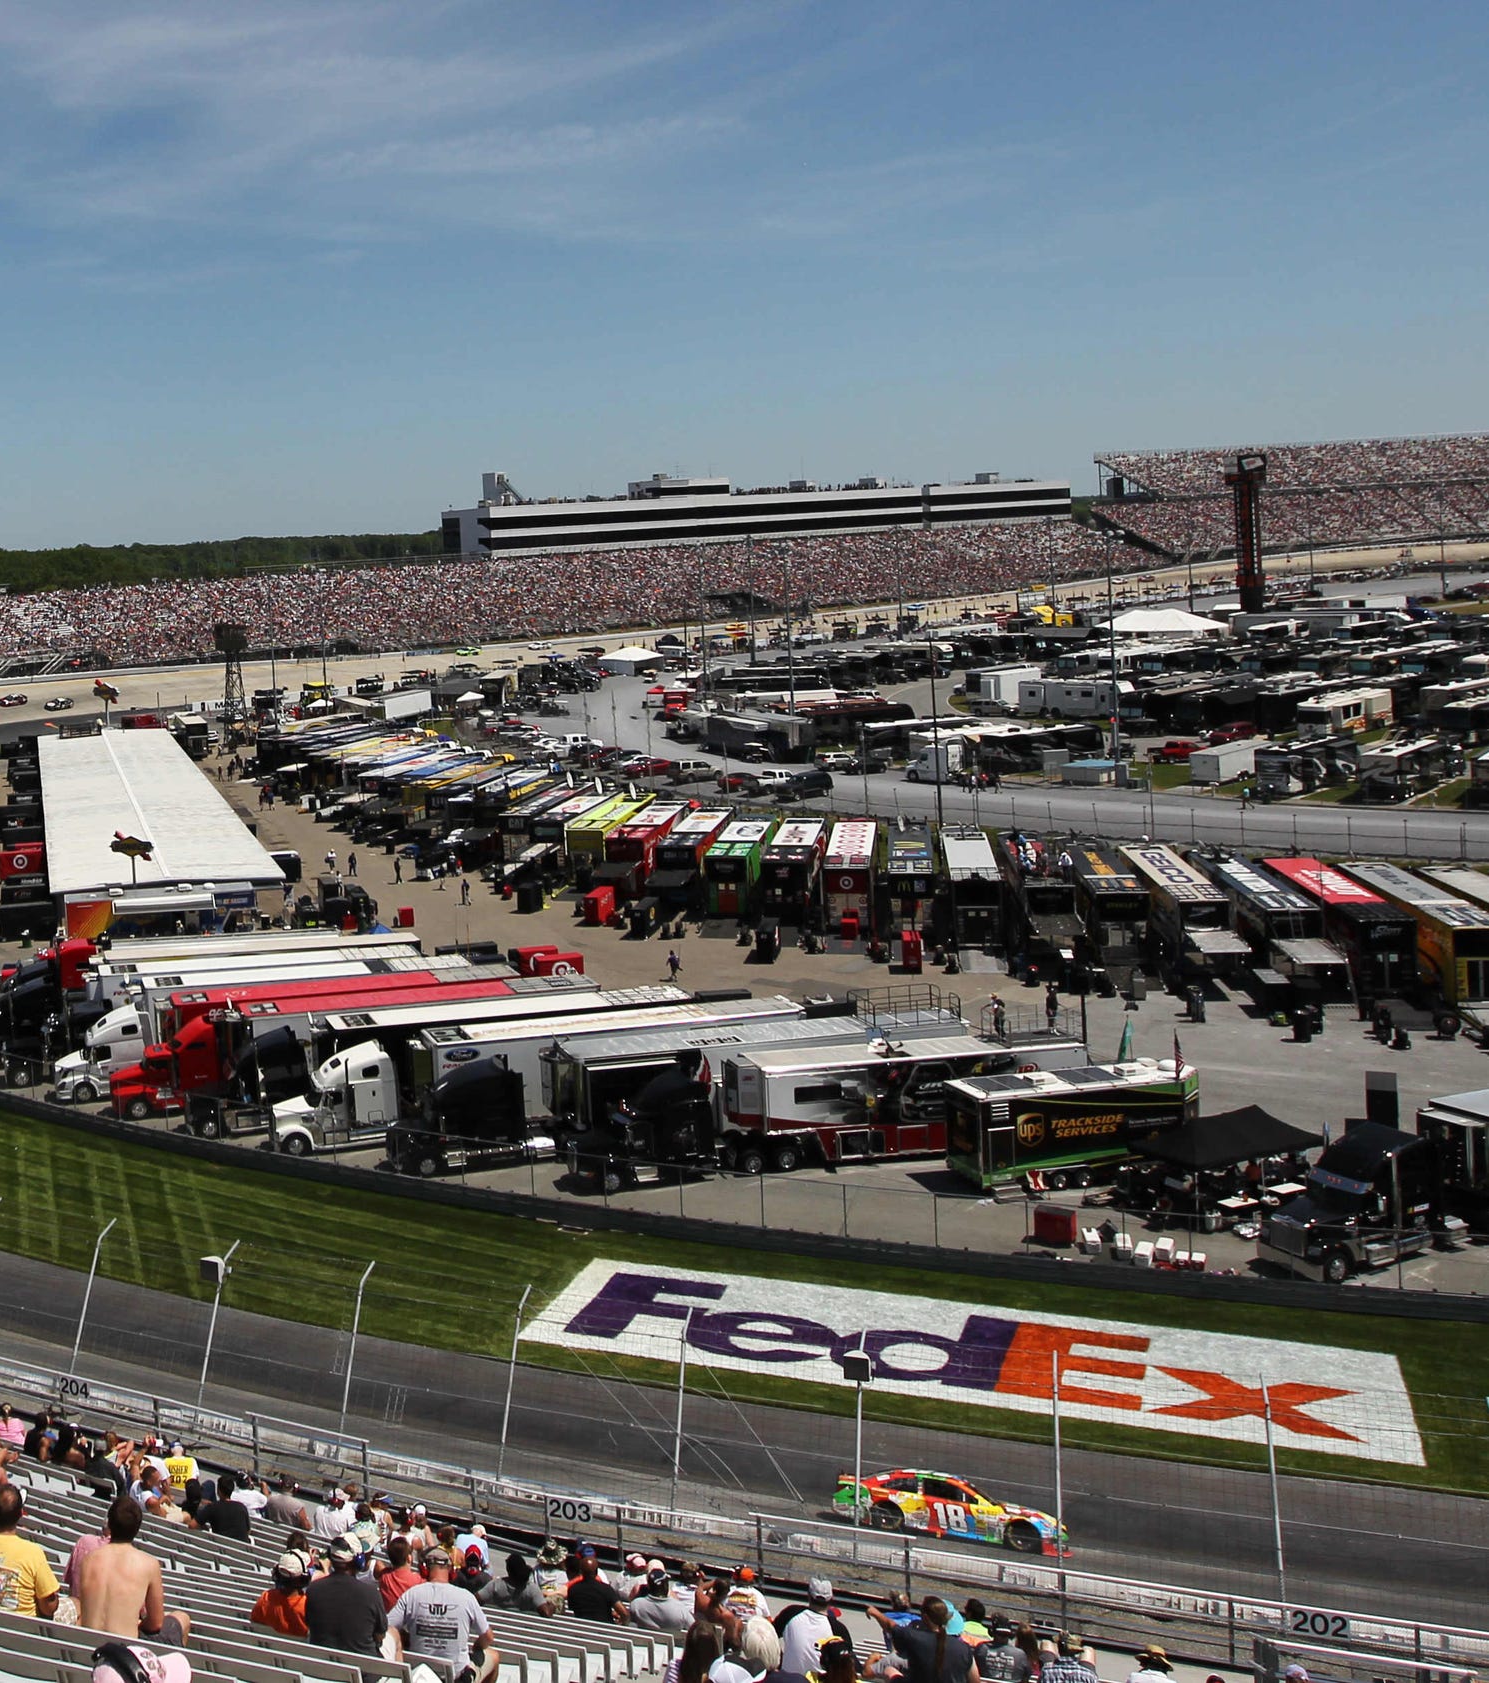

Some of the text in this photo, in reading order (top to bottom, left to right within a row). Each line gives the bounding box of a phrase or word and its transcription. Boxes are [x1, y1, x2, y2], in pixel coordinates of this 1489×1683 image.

[1140, 851, 1195, 884] GEICO
[1019, 1122, 1043, 1143] ups
[1050, 1113, 1125, 1130] TRACKSIDE
[1054, 1123, 1118, 1139] SERVICES
[564, 1272, 1365, 1443] FedEx
[60, 1377, 90, 1399] 204
[548, 1499, 592, 1523] 203
[933, 1501, 968, 1533] 18
[1291, 1610, 1350, 1638] 202
